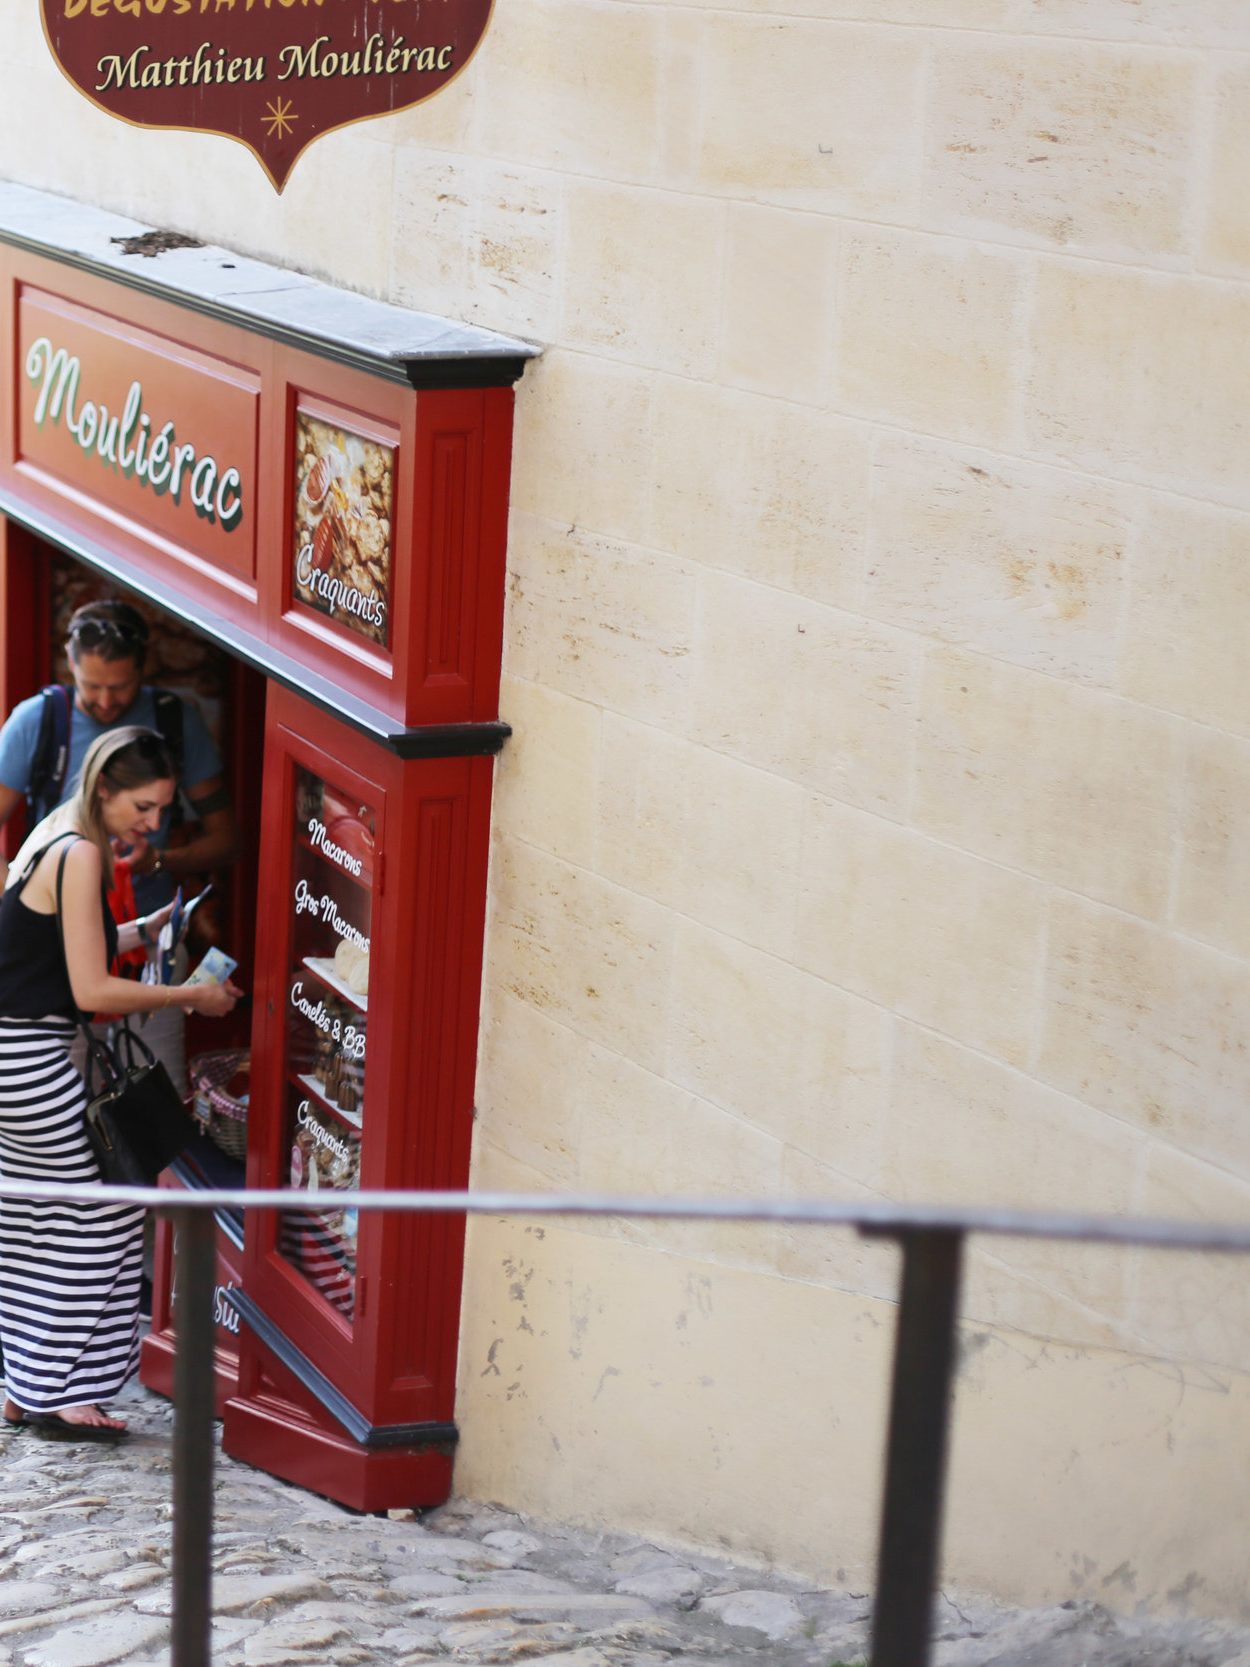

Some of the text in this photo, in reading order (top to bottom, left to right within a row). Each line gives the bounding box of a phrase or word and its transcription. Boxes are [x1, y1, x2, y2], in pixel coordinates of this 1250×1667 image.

[95, 33, 453, 91] Matthieu Mouliérac
[26, 337, 241, 527] Mouliérac
[297, 543, 384, 627] Craquants
[308, 818, 363, 877] Macarons
[295, 880, 371, 953] Gros Macarons
[291, 982, 366, 1058] Canelés & BB
[297, 1100, 349, 1163] Craquants
